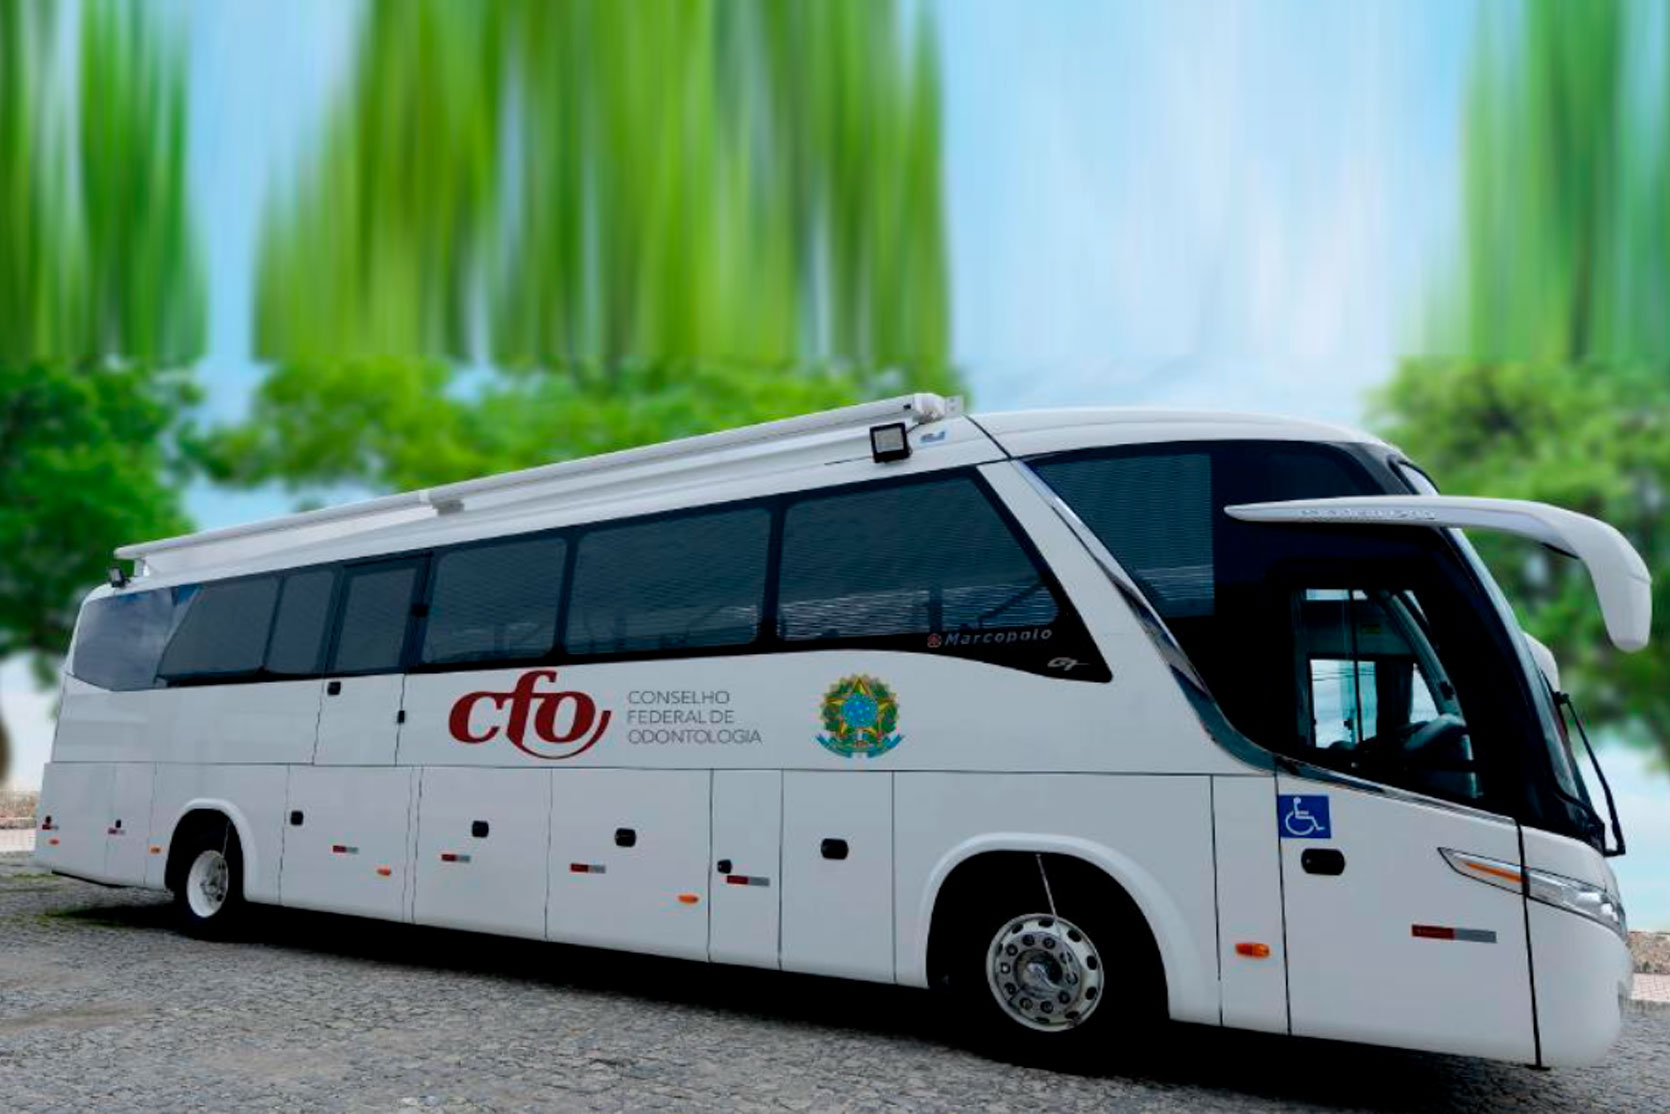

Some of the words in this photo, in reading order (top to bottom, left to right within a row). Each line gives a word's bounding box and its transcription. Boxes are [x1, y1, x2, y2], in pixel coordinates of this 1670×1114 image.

[945, 629, 1053, 646] Marcopolo
[628, 690, 730, 704] CONSELHO
[449, 669, 611, 759] cfo
[628, 709, 707, 724] FEDERAL
[709, 709, 735, 724] DE
[628, 729, 763, 744] ODONTOLOGIA
